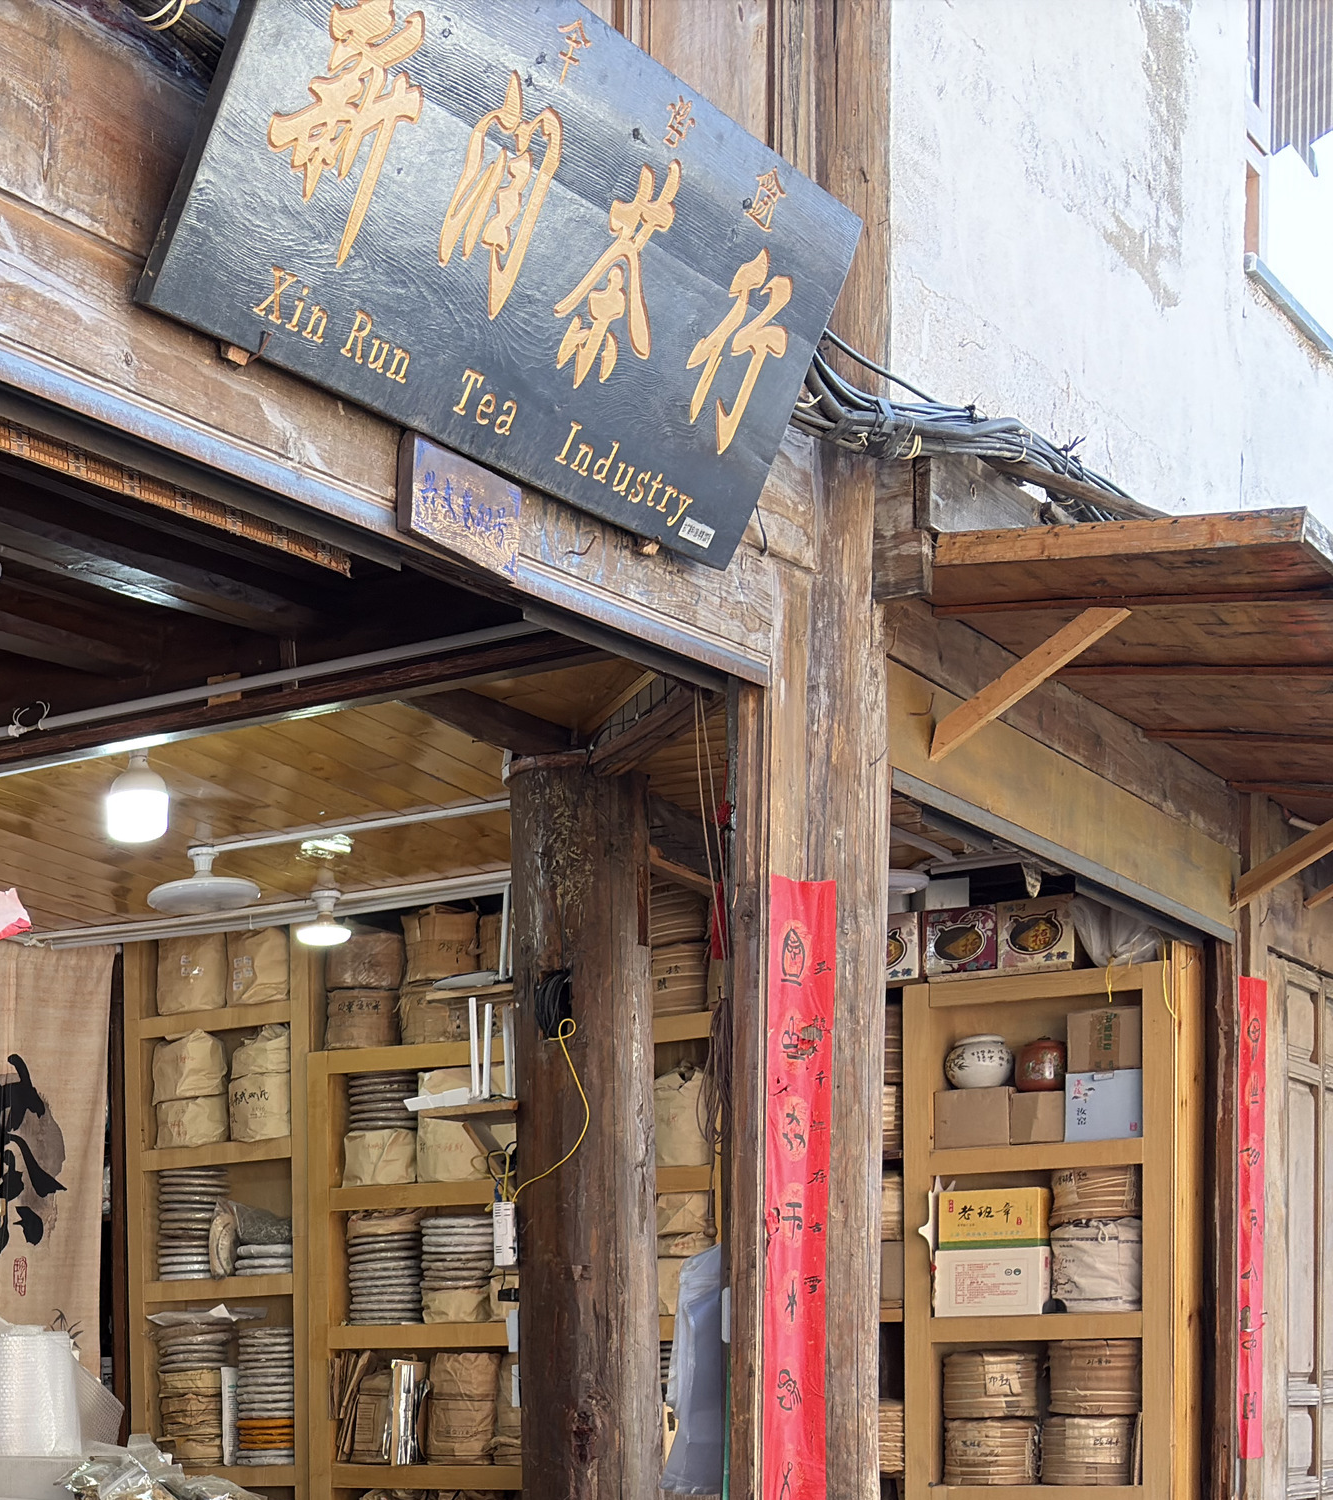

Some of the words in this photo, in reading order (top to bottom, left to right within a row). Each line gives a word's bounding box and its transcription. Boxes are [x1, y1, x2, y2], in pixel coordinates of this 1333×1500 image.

[252, 266, 328, 345] Xin
[341, 311, 411, 385] Run
[452, 368, 520, 436] Tea
[554, 425, 694, 528] Industry
